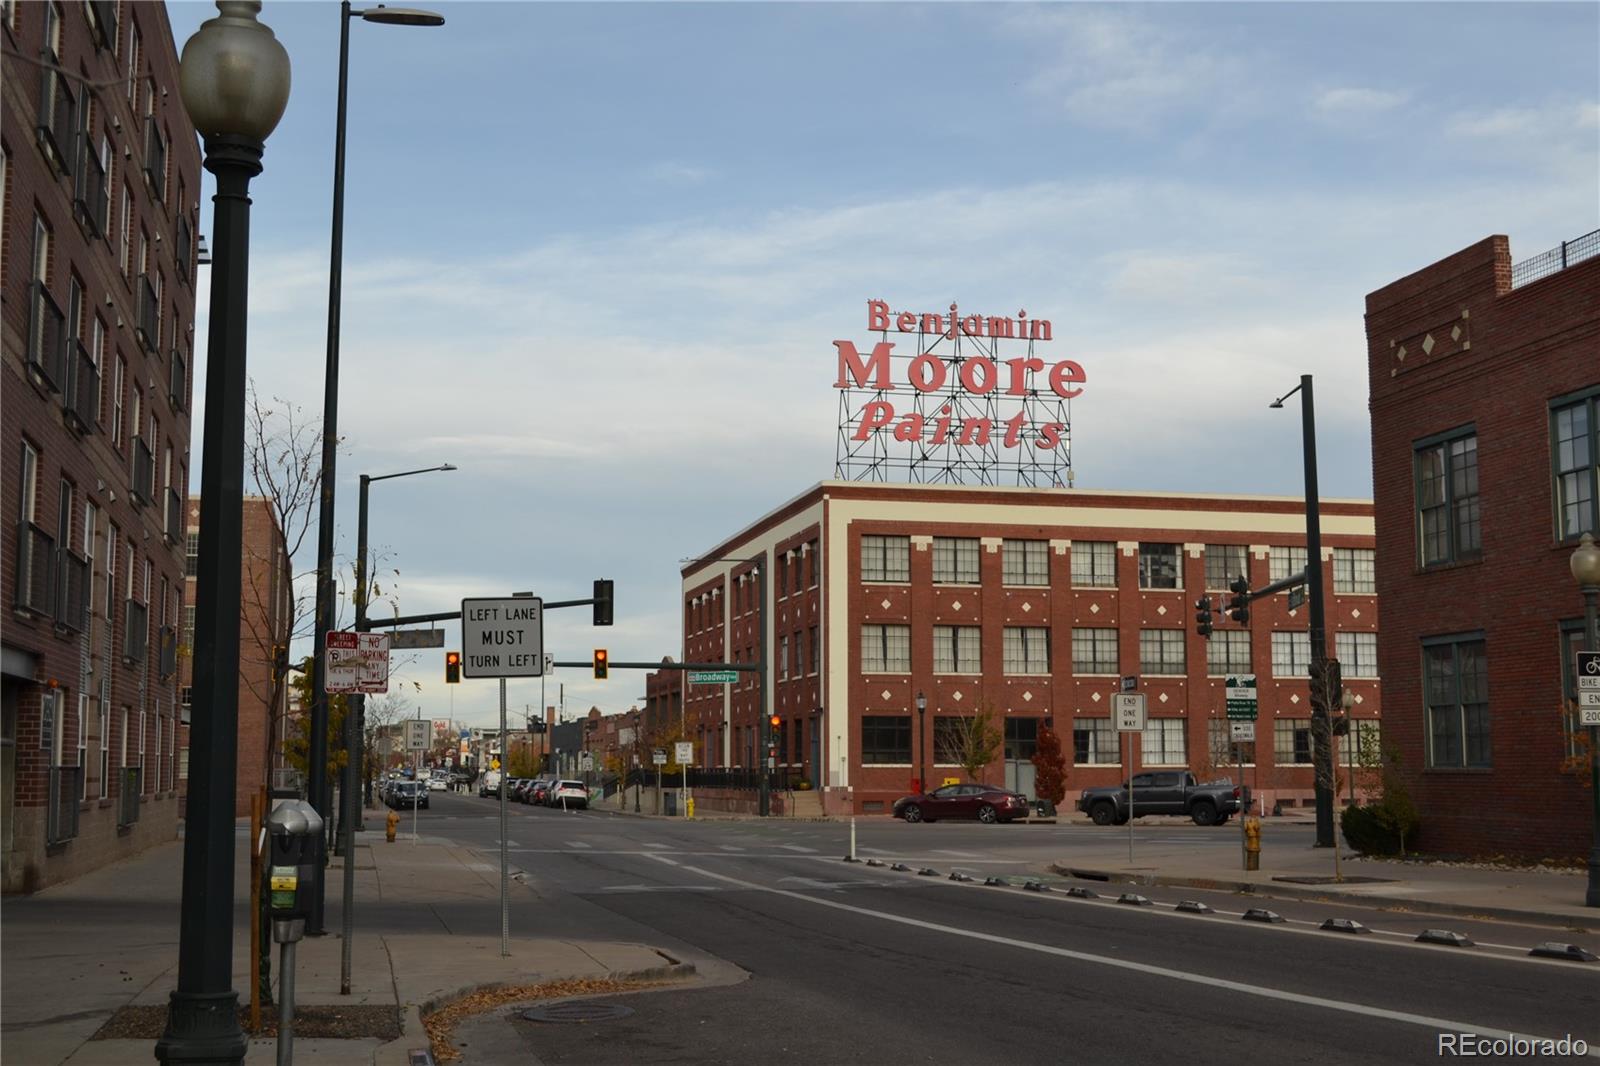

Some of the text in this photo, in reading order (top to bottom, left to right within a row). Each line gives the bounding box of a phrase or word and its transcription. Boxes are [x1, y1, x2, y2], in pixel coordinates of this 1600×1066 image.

[868, 300, 1053, 340] Benjamin
[832, 340, 1087, 398] Moore
[850, 401, 1064, 449] Paints
[470, 608, 536, 621] LEFT LANE
[368, 636, 380, 648] NO
[482, 630, 524, 645] MUST
[360, 650, 386, 661] PARKING
[469, 654, 537, 668] TURN LEFT
[366, 671, 380, 679] TIME
[695, 673, 730, 682] Broadway
[1581, 678, 1597, 687] BIKE
[1123, 697, 1136, 705] END
